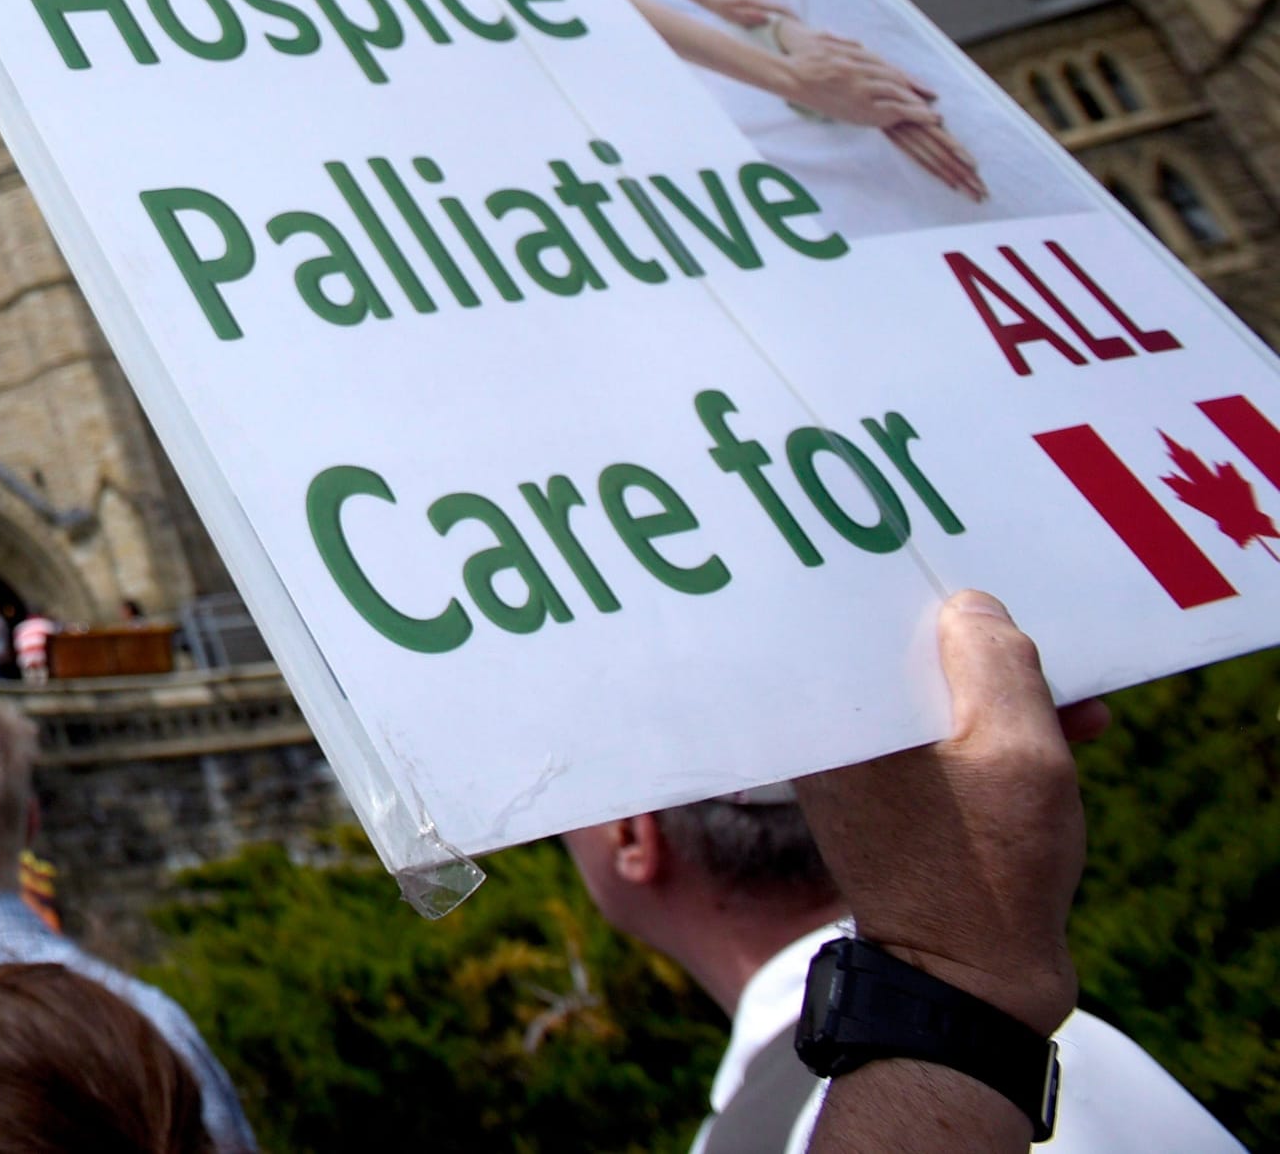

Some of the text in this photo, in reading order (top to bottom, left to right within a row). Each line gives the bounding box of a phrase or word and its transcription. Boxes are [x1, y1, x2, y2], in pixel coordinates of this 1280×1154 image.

[138, 139, 850, 342] Palliative
[945, 240, 1182, 376] ALL
[304, 388, 966, 655] Care for
